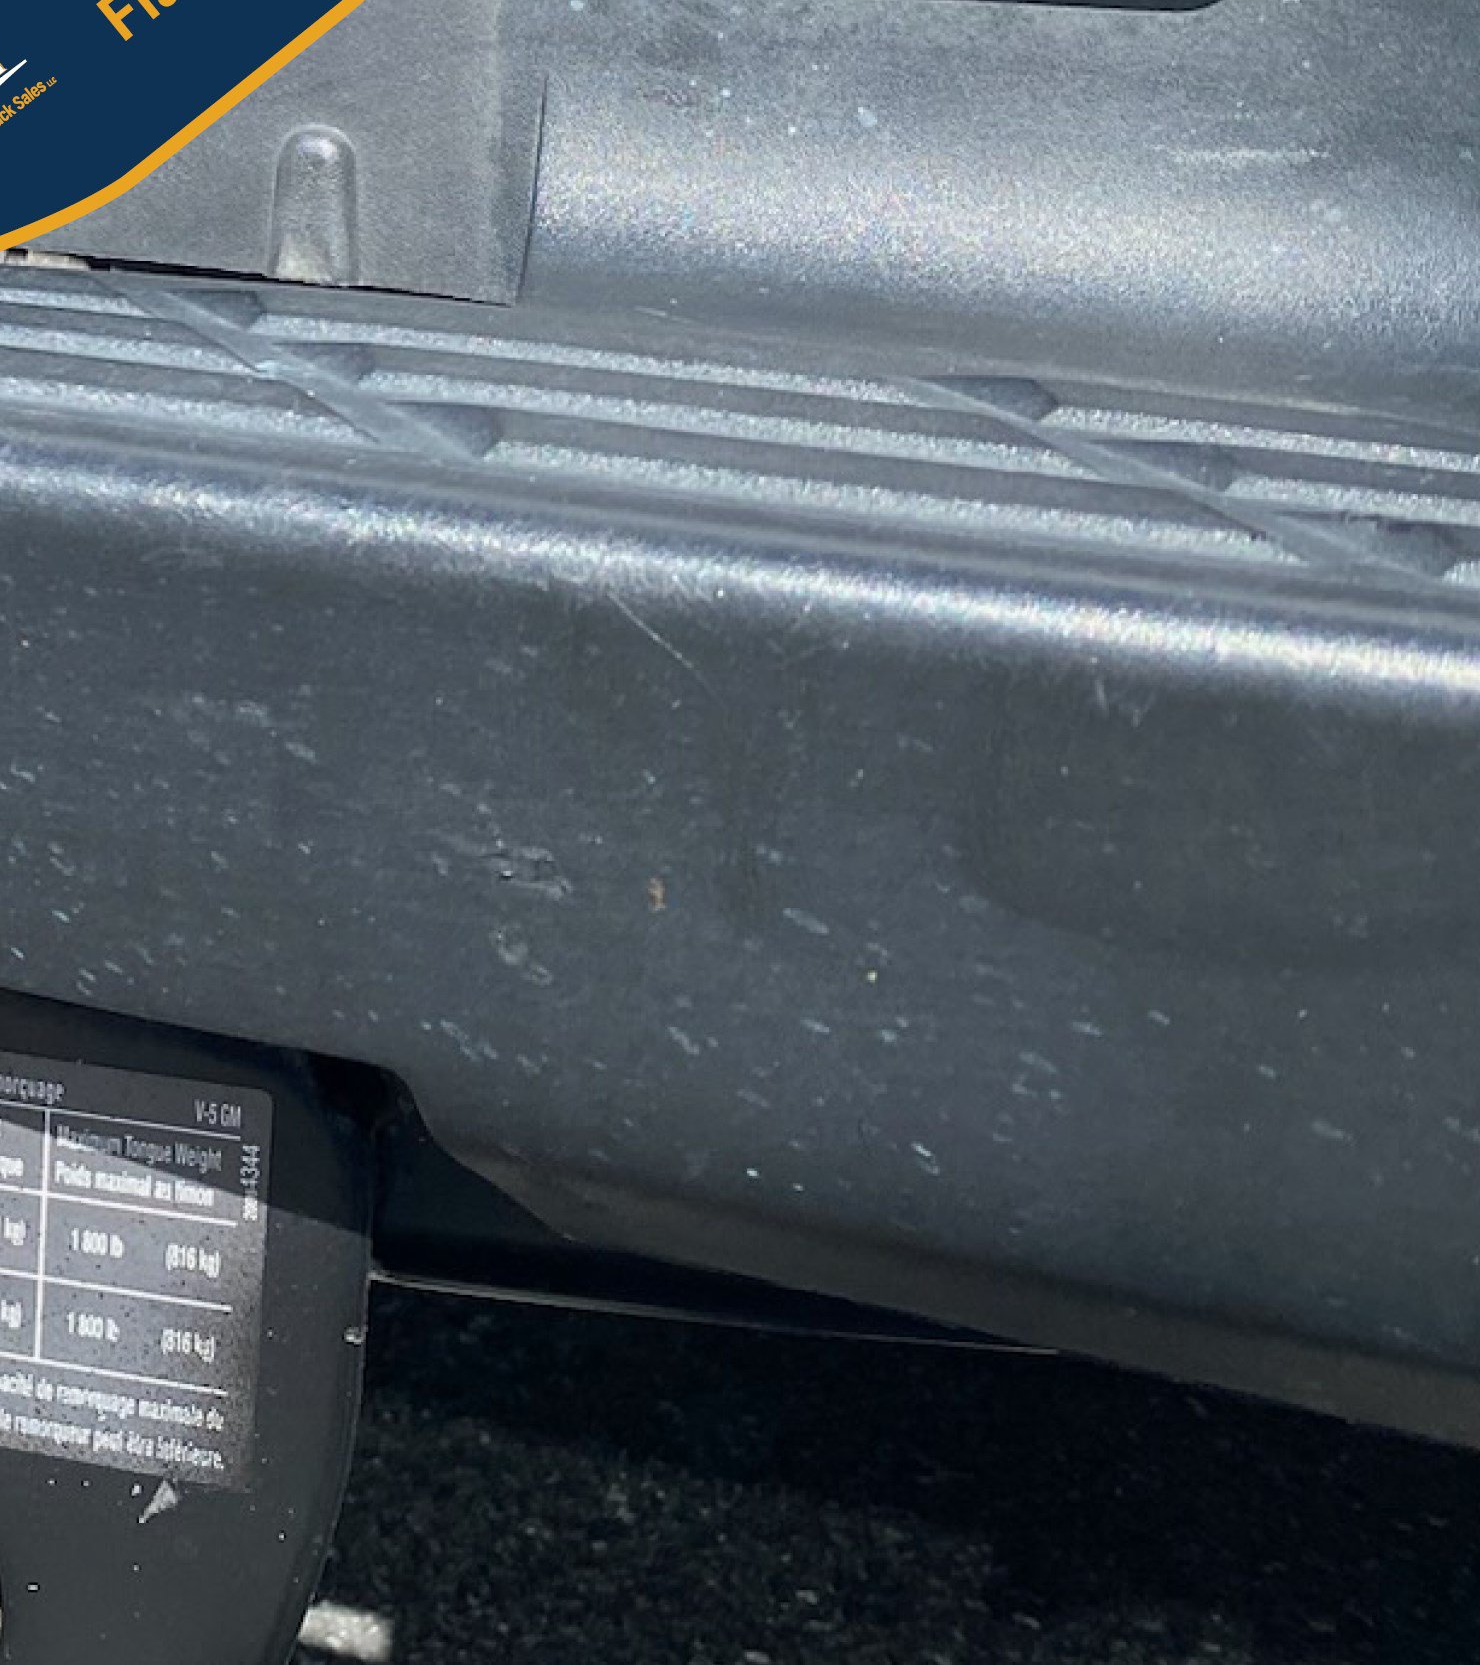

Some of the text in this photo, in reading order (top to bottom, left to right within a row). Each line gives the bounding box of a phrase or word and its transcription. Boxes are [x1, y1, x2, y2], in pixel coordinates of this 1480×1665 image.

[194, 1099, 240, 1127] V-5 GM
[124, 1134, 172, 1165] Tongue
[175, 1141, 222, 1174] Weight
[71, 1227, 79, 1251] 1
[109, 1234, 124, 1259] lb
[198, 1247, 221, 1279] kg)
[0, 1299, 22, 1327] kg)
[66, 1311, 75, 1333] 1
[193, 1332, 215, 1363] kg)
